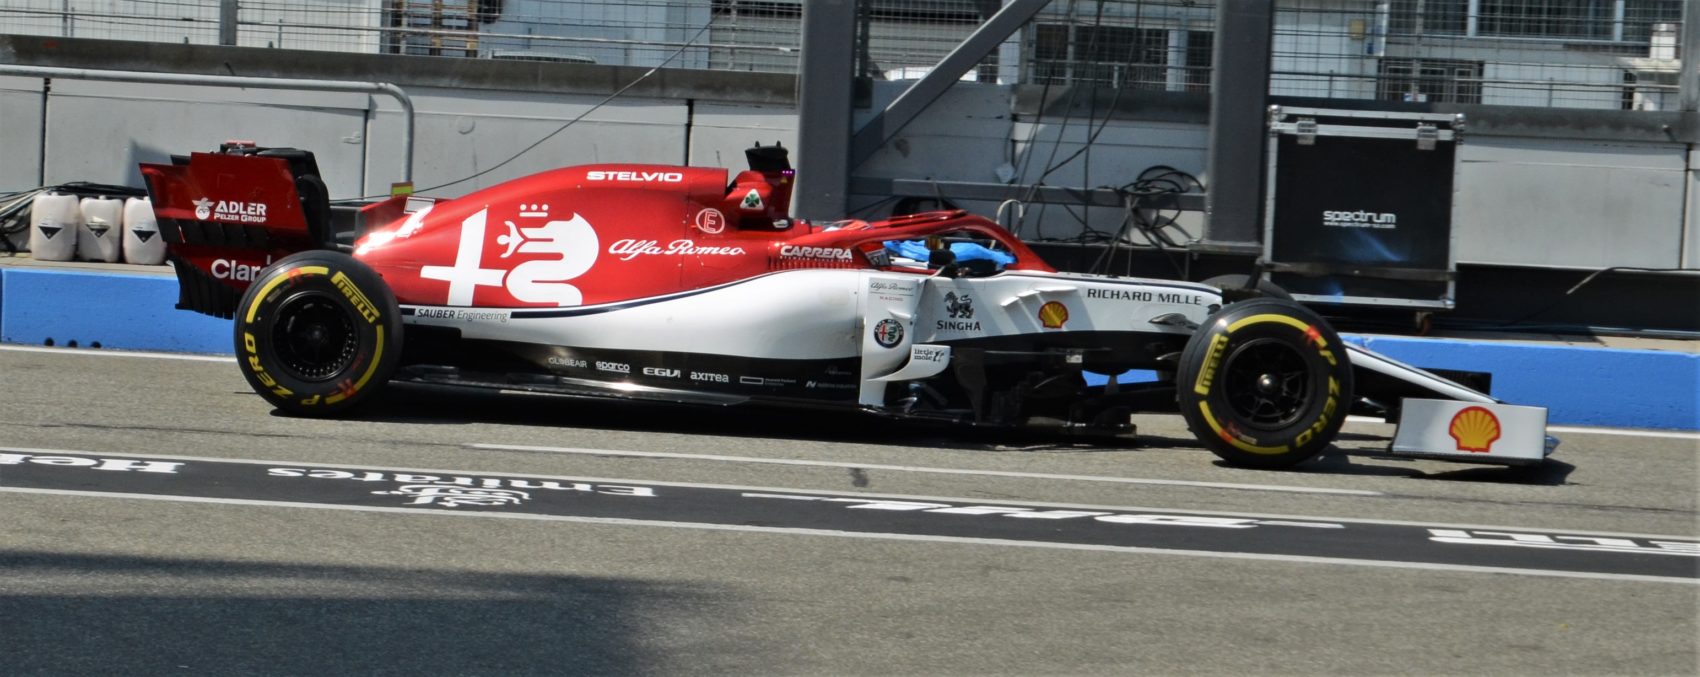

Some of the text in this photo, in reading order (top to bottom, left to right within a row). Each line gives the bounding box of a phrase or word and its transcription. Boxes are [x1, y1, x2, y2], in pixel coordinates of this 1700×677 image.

[586, 170, 683, 182] STELVIO
[215, 200, 267, 216] ADLER
[214, 212, 267, 222] PELZER GROUP
[1323, 210, 1396, 223] spectrum
[608, 239, 746, 261] Alfa Romeo
[780, 245, 853, 260] CARRERA
[330, 271, 381, 324] PIRELLI
[1087, 288, 1202, 305] RICHARD MILLE
[417, 308, 507, 323] SAUBER Engineering
[936, 319, 981, 331] SINGHA
[596, 361, 630, 373] sparco
[1194, 333, 1229, 395] PIRELLI
[267, 467, 660, 498] Emirates
